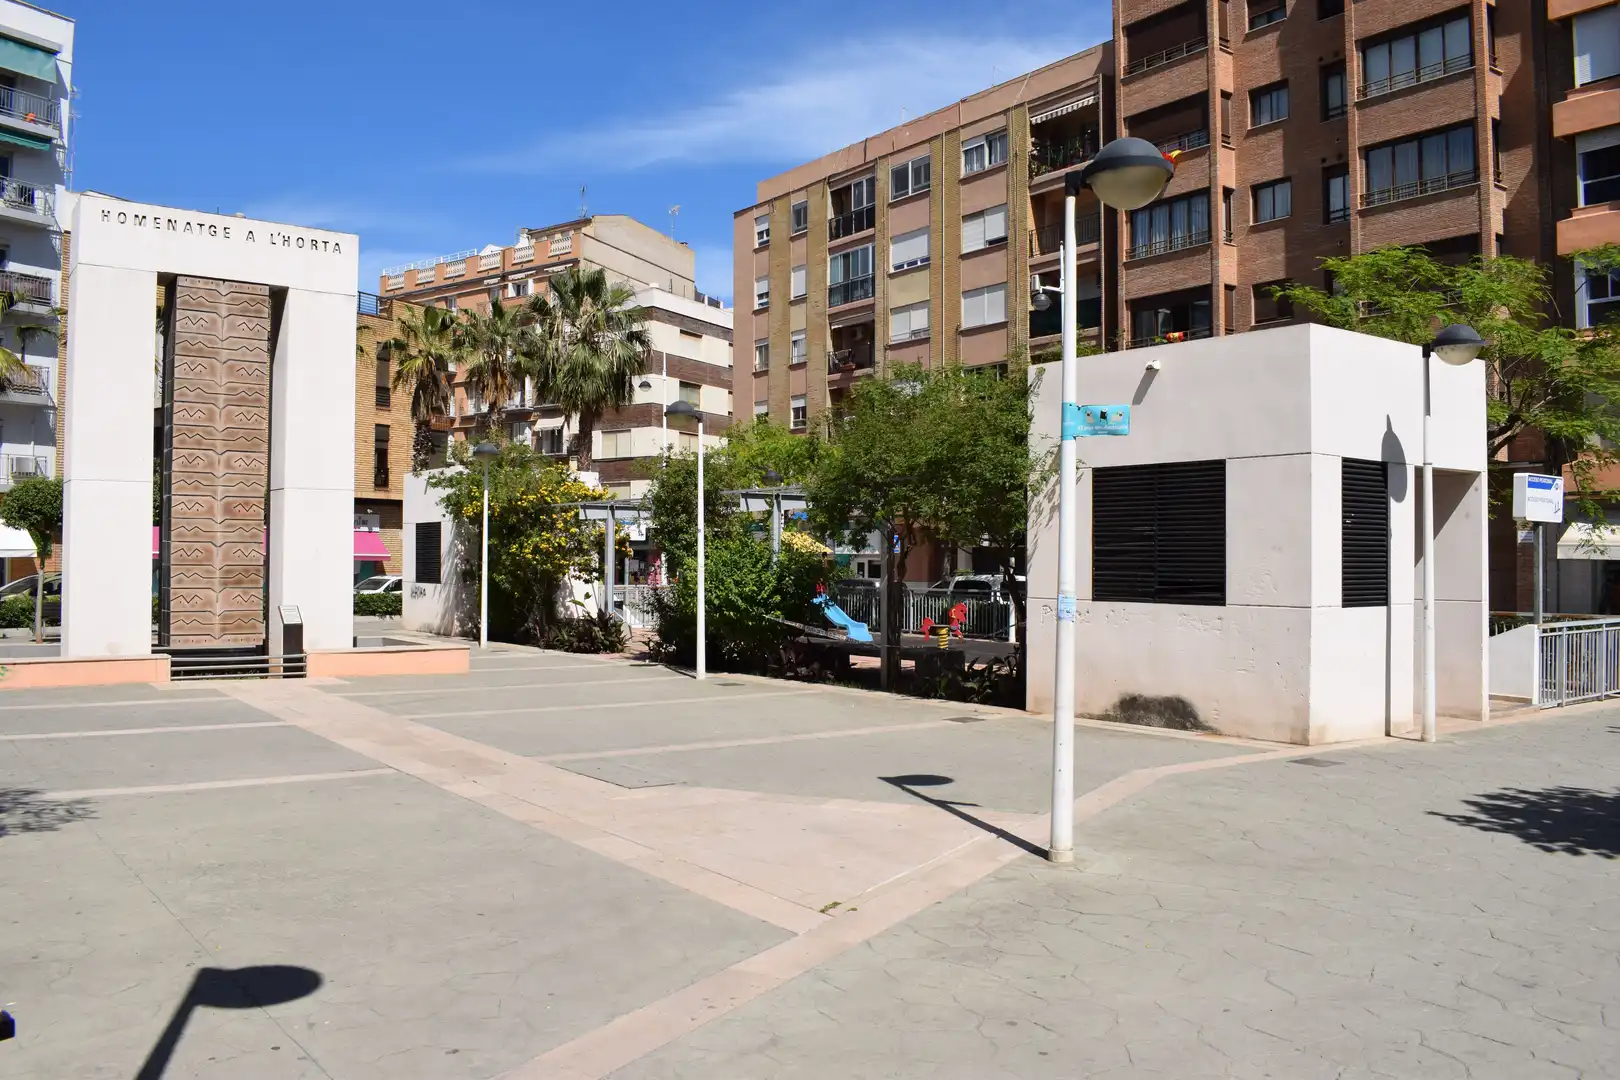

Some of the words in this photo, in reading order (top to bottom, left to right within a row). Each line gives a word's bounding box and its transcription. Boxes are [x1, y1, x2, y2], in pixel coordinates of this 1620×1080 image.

[101, 209, 231, 239] HOMENATGE
[245, 230, 256, 243] A
[270, 231, 342, 255] L'HORTA
